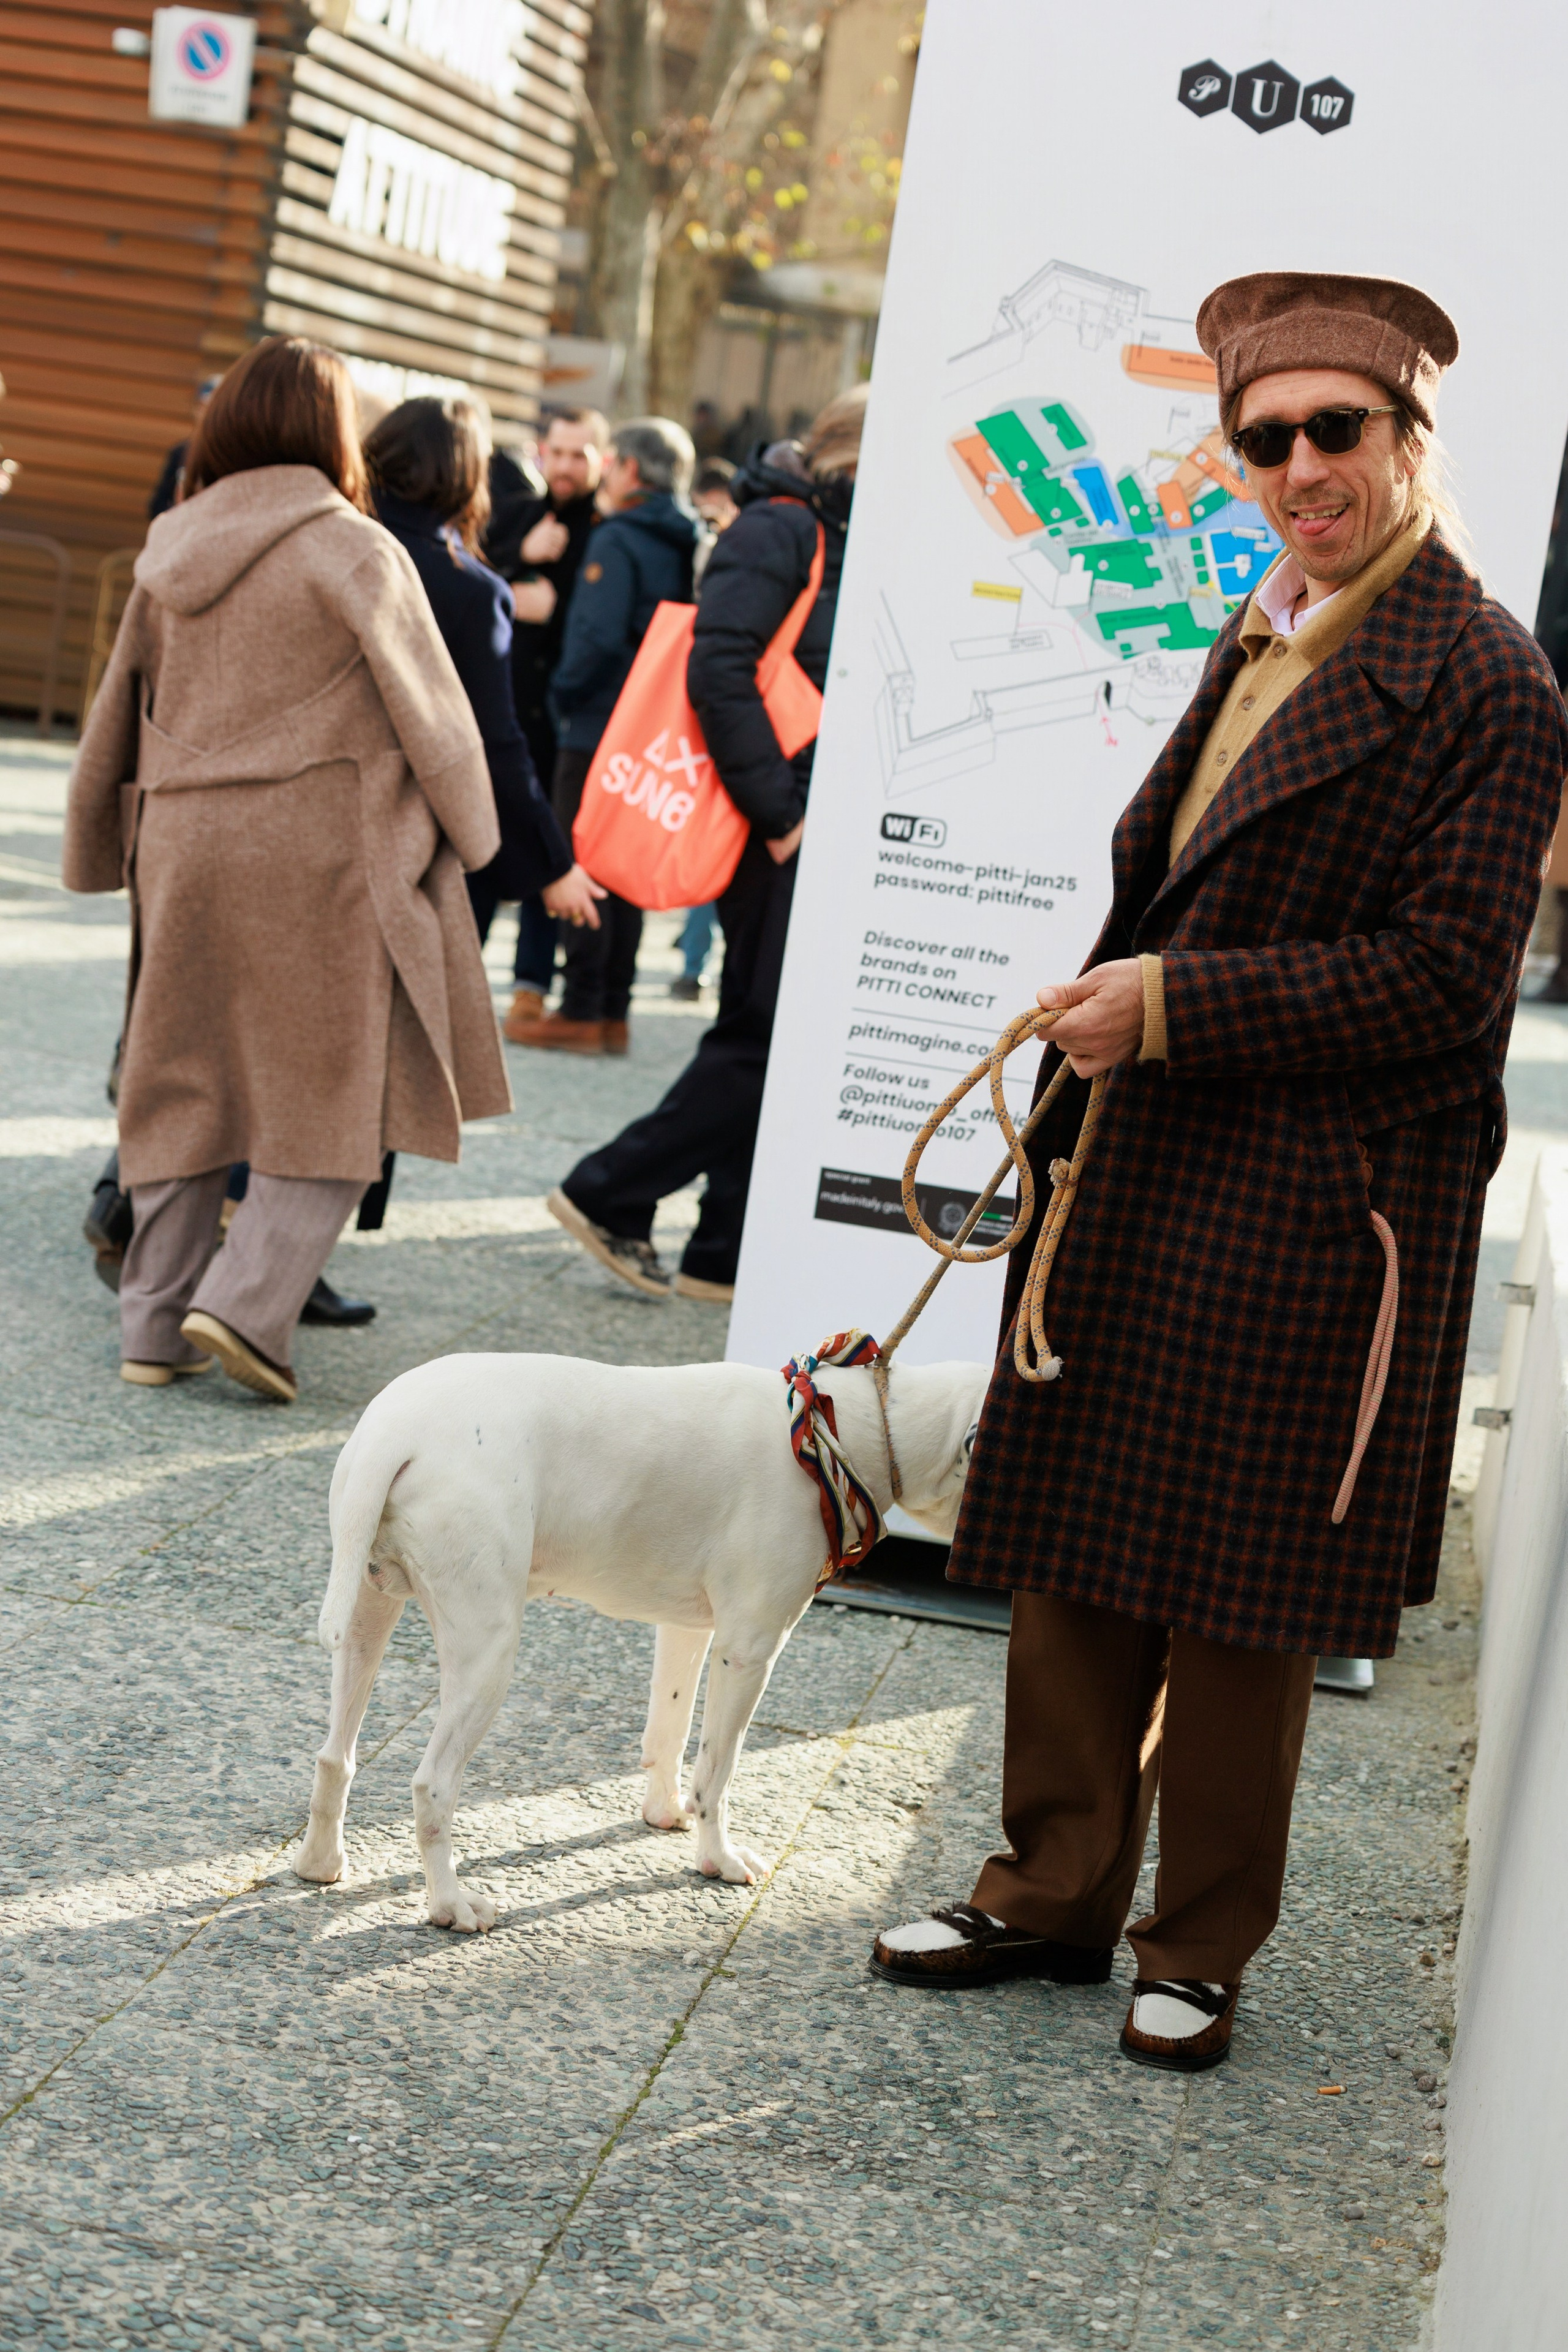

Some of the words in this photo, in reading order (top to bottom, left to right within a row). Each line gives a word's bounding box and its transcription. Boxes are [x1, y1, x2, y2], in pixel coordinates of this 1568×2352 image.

[1188, 75, 1221, 101] P
[1251, 78, 1284, 117] U
[1311, 93, 1344, 121] 107
[879, 851, 1077, 891] welcome-pitti-jan25
[875, 873, 973, 898] password:
[977, 888, 1054, 910] pittifree
[864, 931, 947, 956] Discover
[951, 944, 974, 961] all
[979, 948, 1009, 966] the
[861, 954, 928, 976] brands
[932, 967, 957, 980] on
[857, 976, 901, 994] PITTI
[905, 983, 997, 1009] CONNECT
[848, 1023, 1008, 1060] pittimagine.co
[843, 1064, 904, 1085] Follow
[908, 1075, 930, 1090] us
